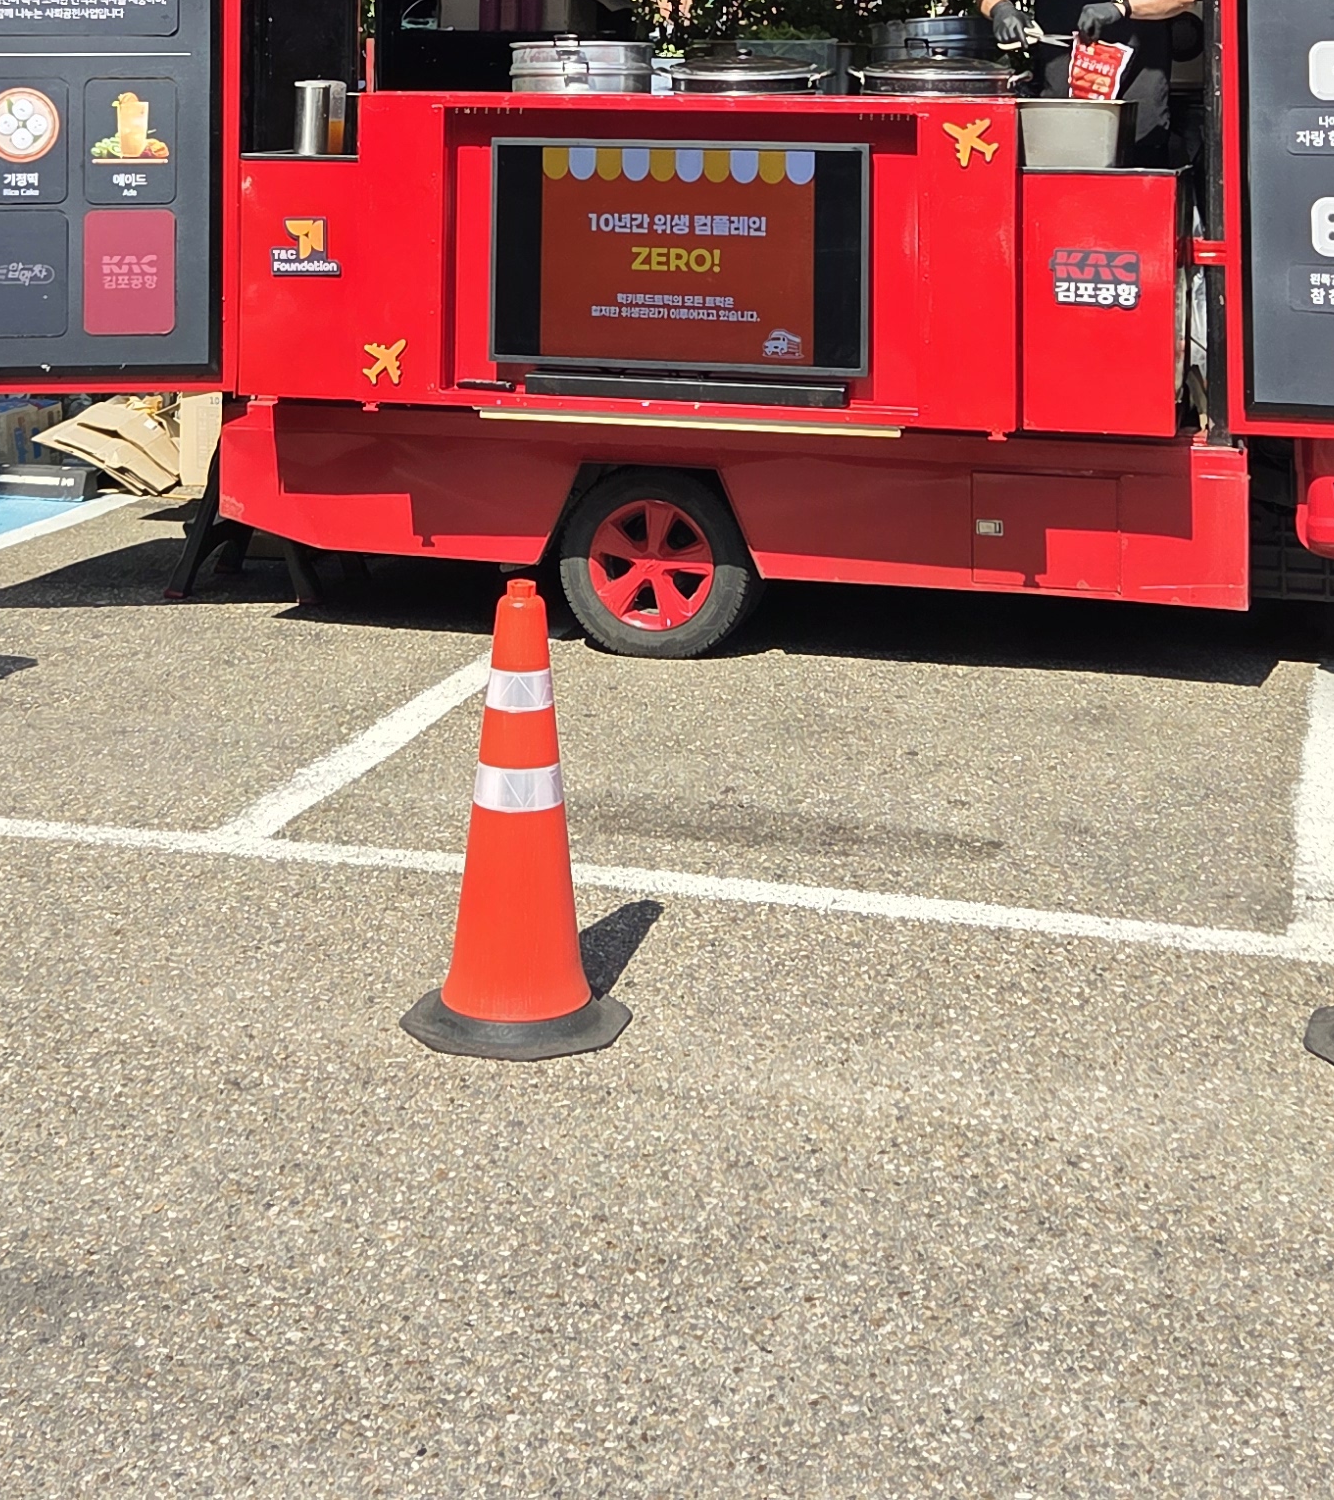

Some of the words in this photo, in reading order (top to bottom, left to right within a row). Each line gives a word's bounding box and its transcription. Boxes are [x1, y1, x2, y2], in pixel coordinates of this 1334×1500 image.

[15, 7, 43, 20] 나누는
[1296, 130, 1325, 147] 자랑
[112, 172, 148, 187] 에이드
[588, 212, 649, 234] 10년간
[653, 214, 690, 235] 위생
[693, 214, 767, 237] 컴플레인
[272, 249, 297, 260] T&C
[630, 246, 722, 273] ZERO!
[102, 254, 158, 274] KAC
[273, 260, 338, 272] Foundation
[1054, 251, 1137, 282] KAC
[102, 275, 158, 290] 김포공항
[684, 295, 704, 306] 모든
[1055, 281, 1139, 306] 김포공항
[1310, 288, 1326, 305] 참
[620, 306, 668, 320] 위생관리가
[669, 308, 718, 321] 이루어지고
[719, 310, 761, 323] 있습니다.
